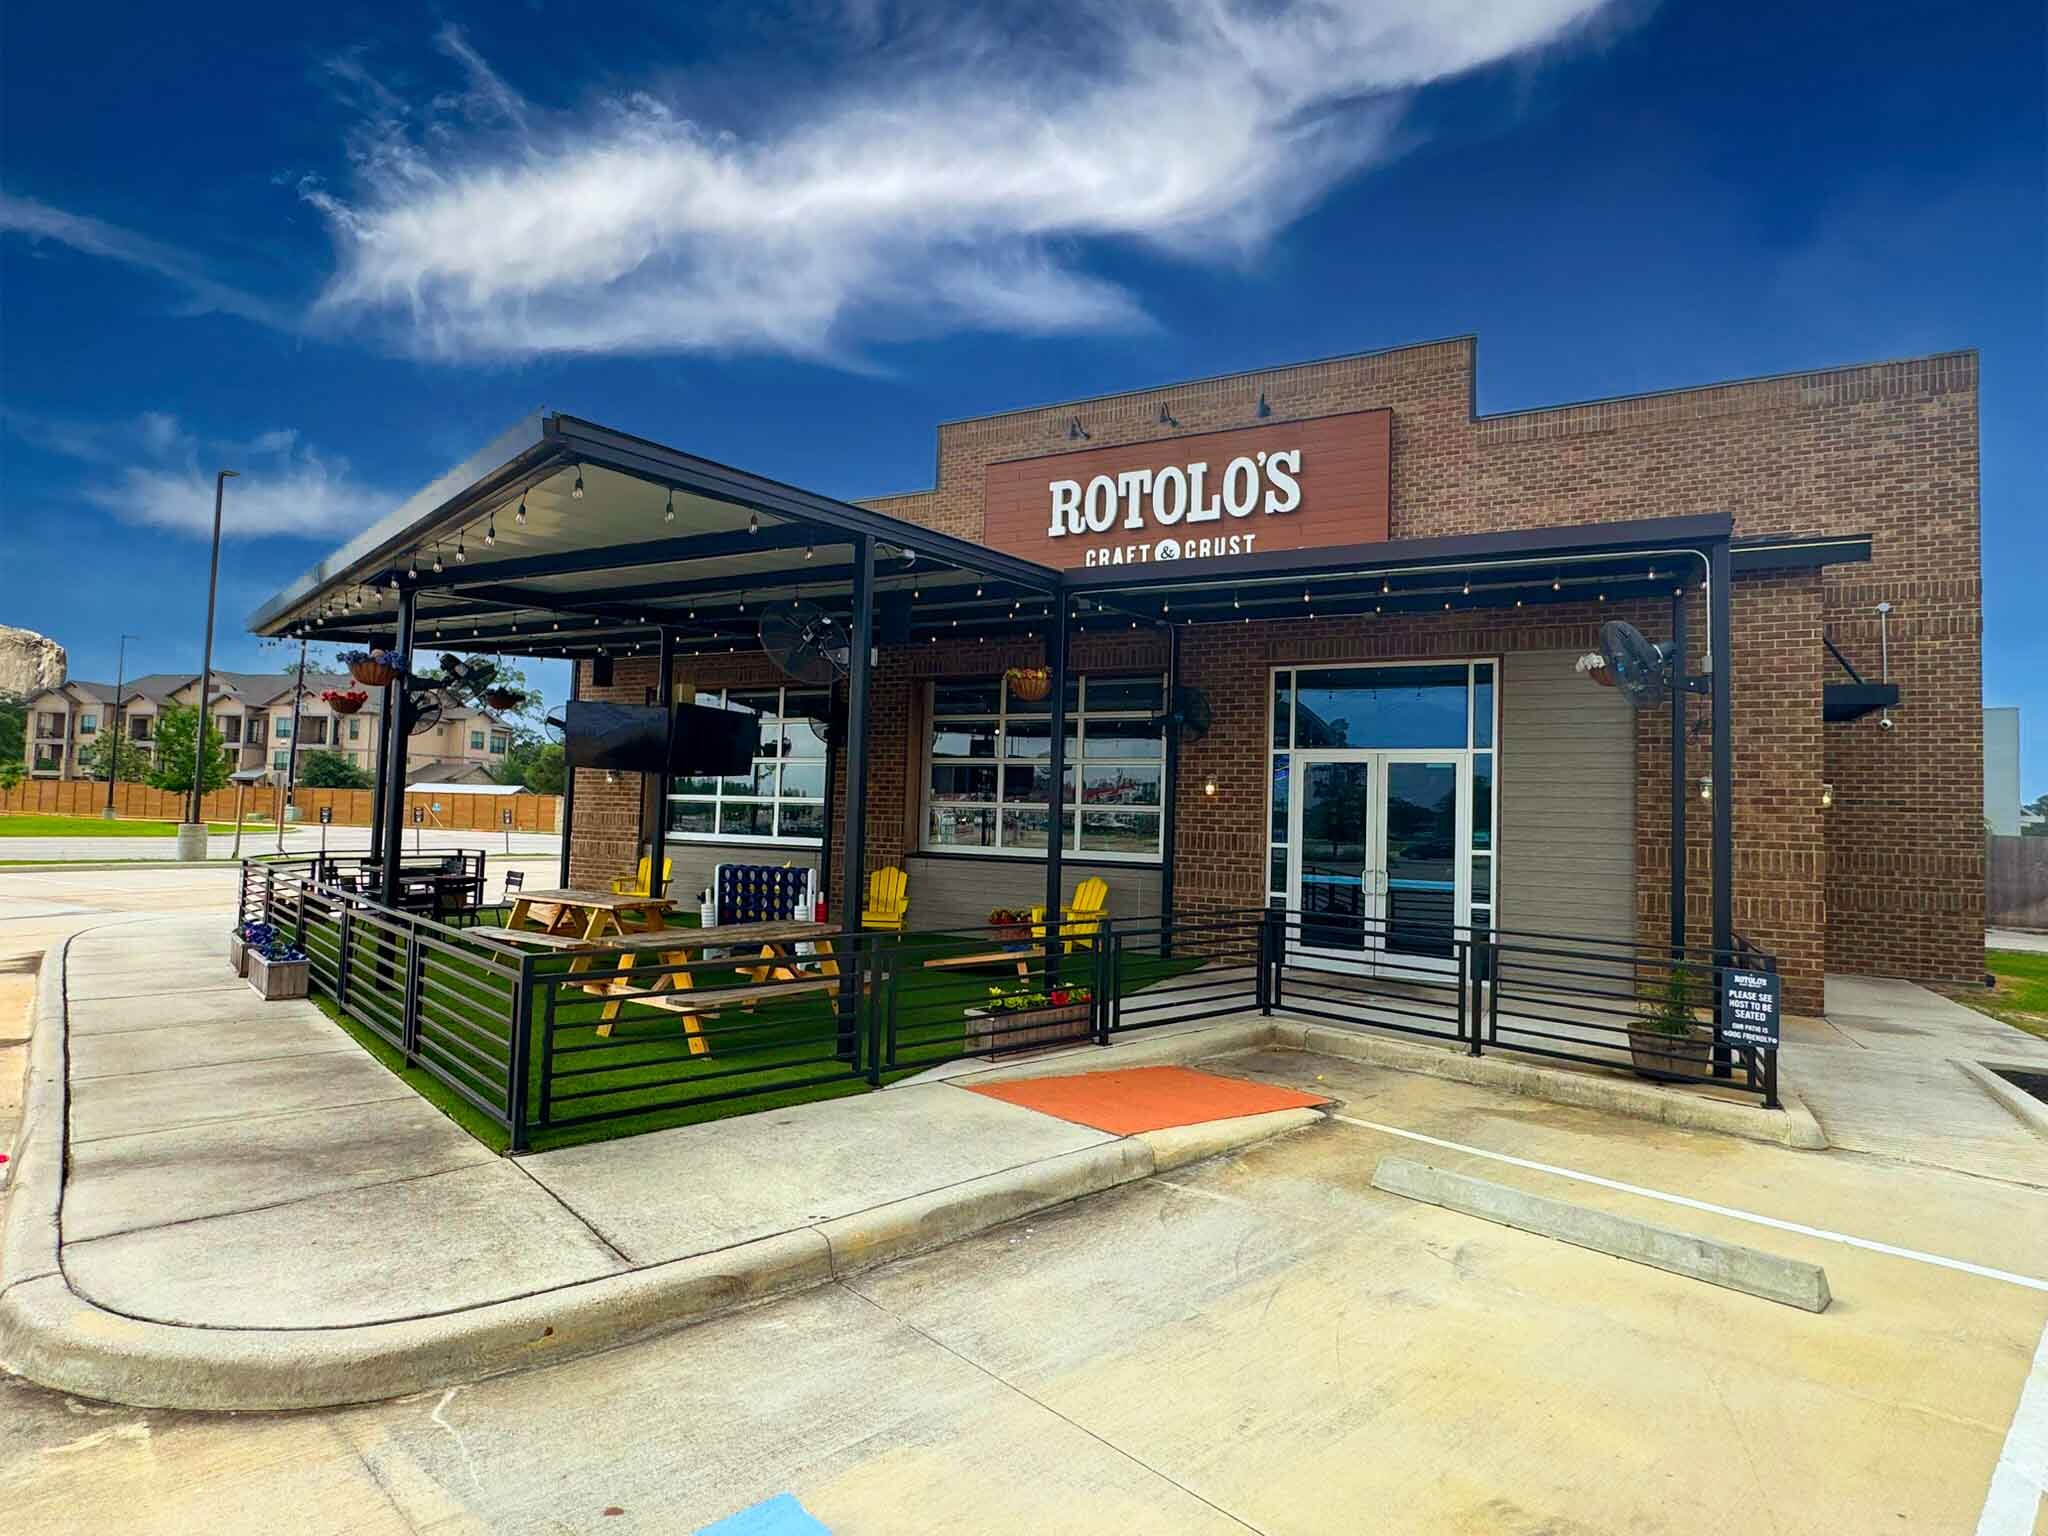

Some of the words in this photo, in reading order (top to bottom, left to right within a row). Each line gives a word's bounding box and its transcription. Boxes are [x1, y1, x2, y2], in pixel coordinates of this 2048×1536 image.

[1047, 449, 1301, 537] ROTOLO'S
[1085, 544, 1151, 568] CRAFT
[1185, 533, 1256, 559] CRUST
[1729, 990, 1757, 1001] PLEASE
[1758, 993, 1773, 1003] SEE
[1729, 999, 1748, 1008] HOST
[1751, 1002, 1760, 1011] TO
[1762, 1004, 1772, 1012] BE
[1735, 1010, 1766, 1021] SEATED
